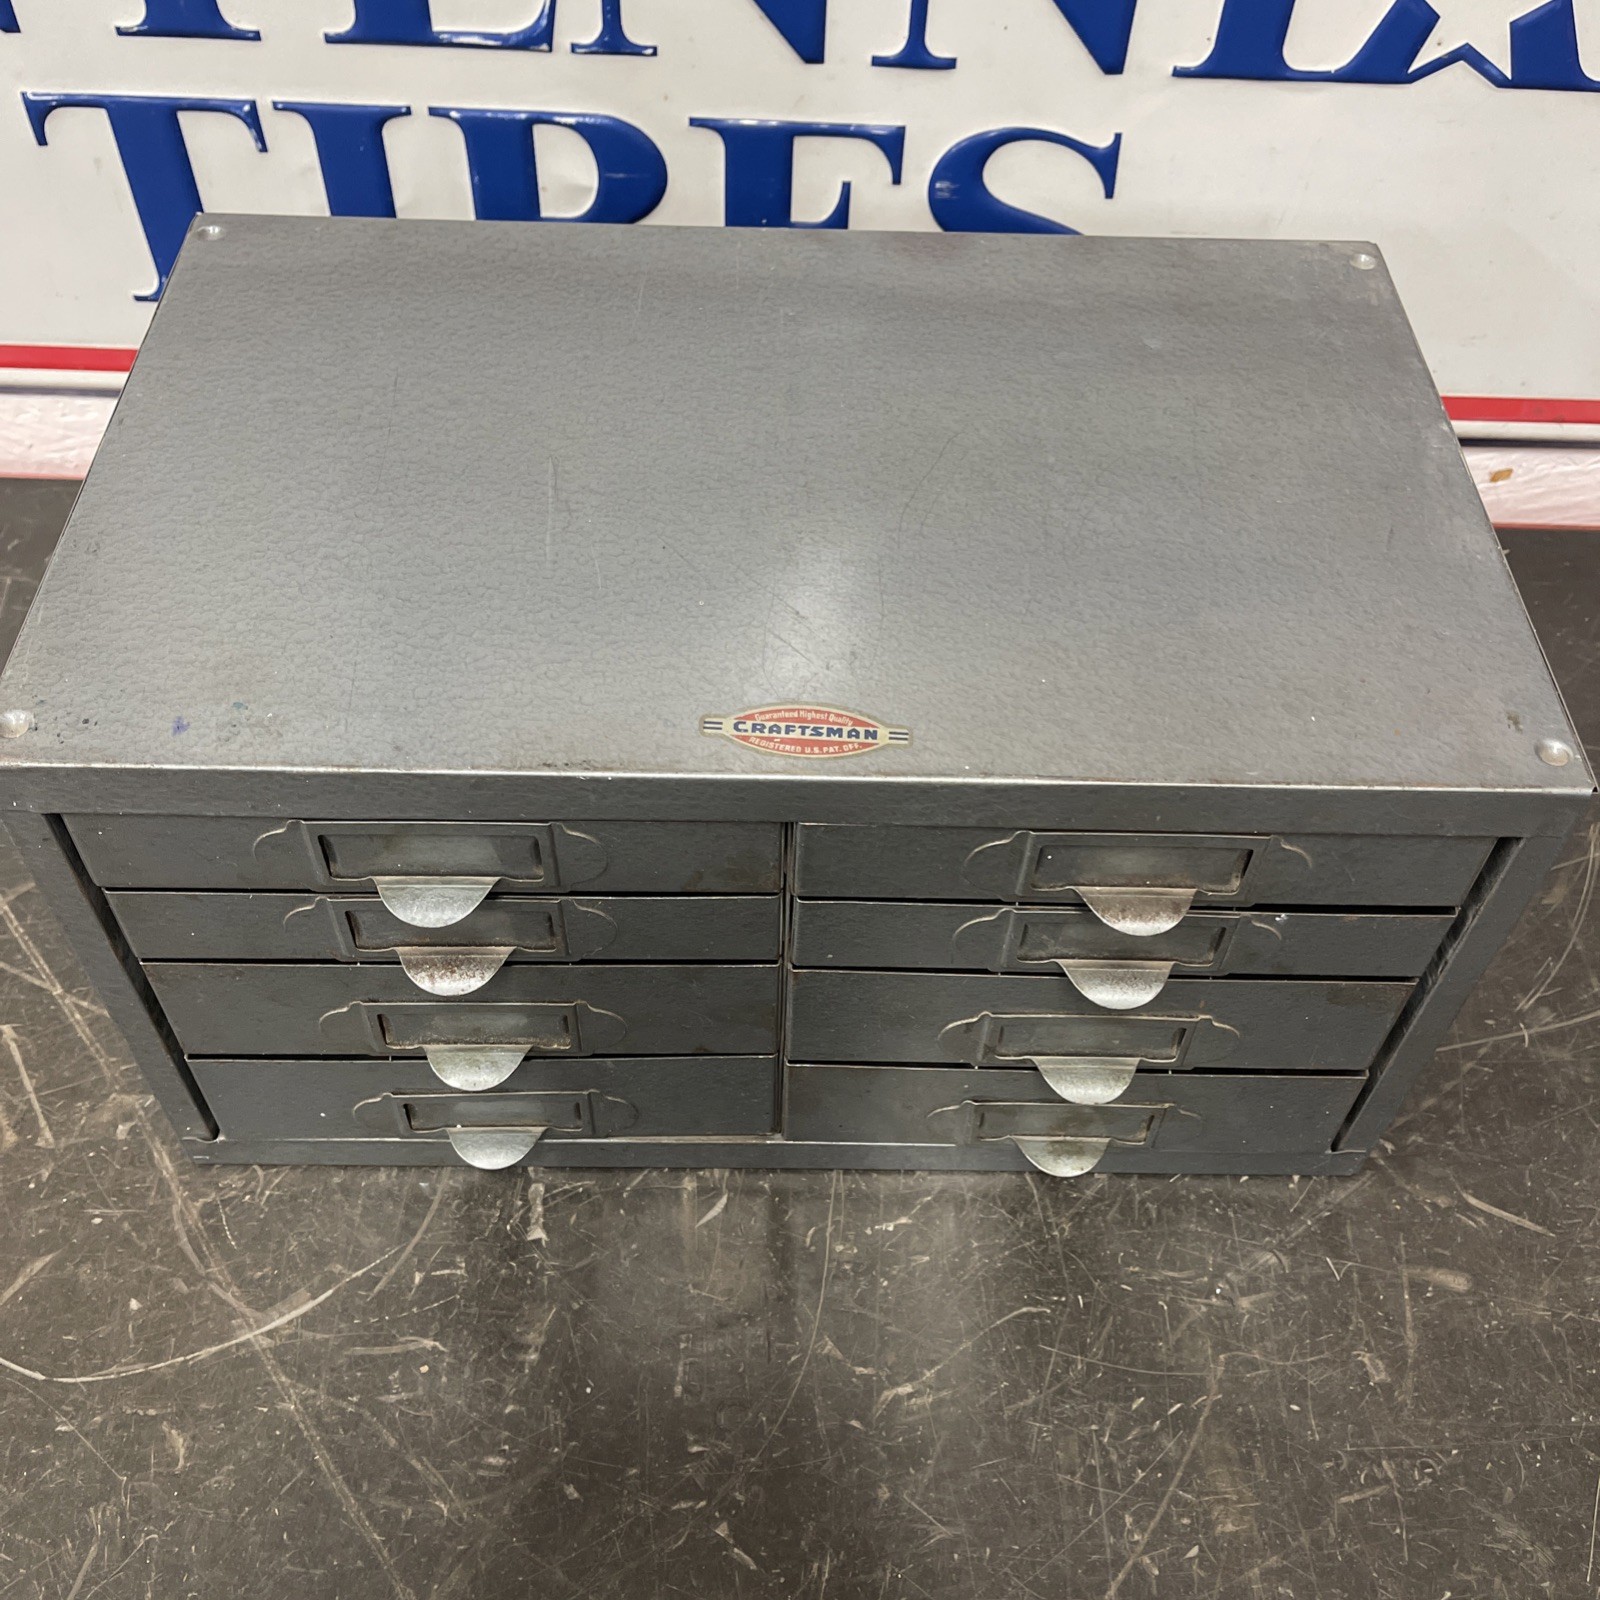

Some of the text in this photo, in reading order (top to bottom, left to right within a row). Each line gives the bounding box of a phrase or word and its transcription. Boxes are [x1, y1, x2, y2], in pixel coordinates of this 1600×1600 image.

[754, 710, 854, 726] Guaranteed Highest Quality
[733, 720, 878, 741] CRAFTSMAN
[748, 736, 802, 753] REGISTERED
